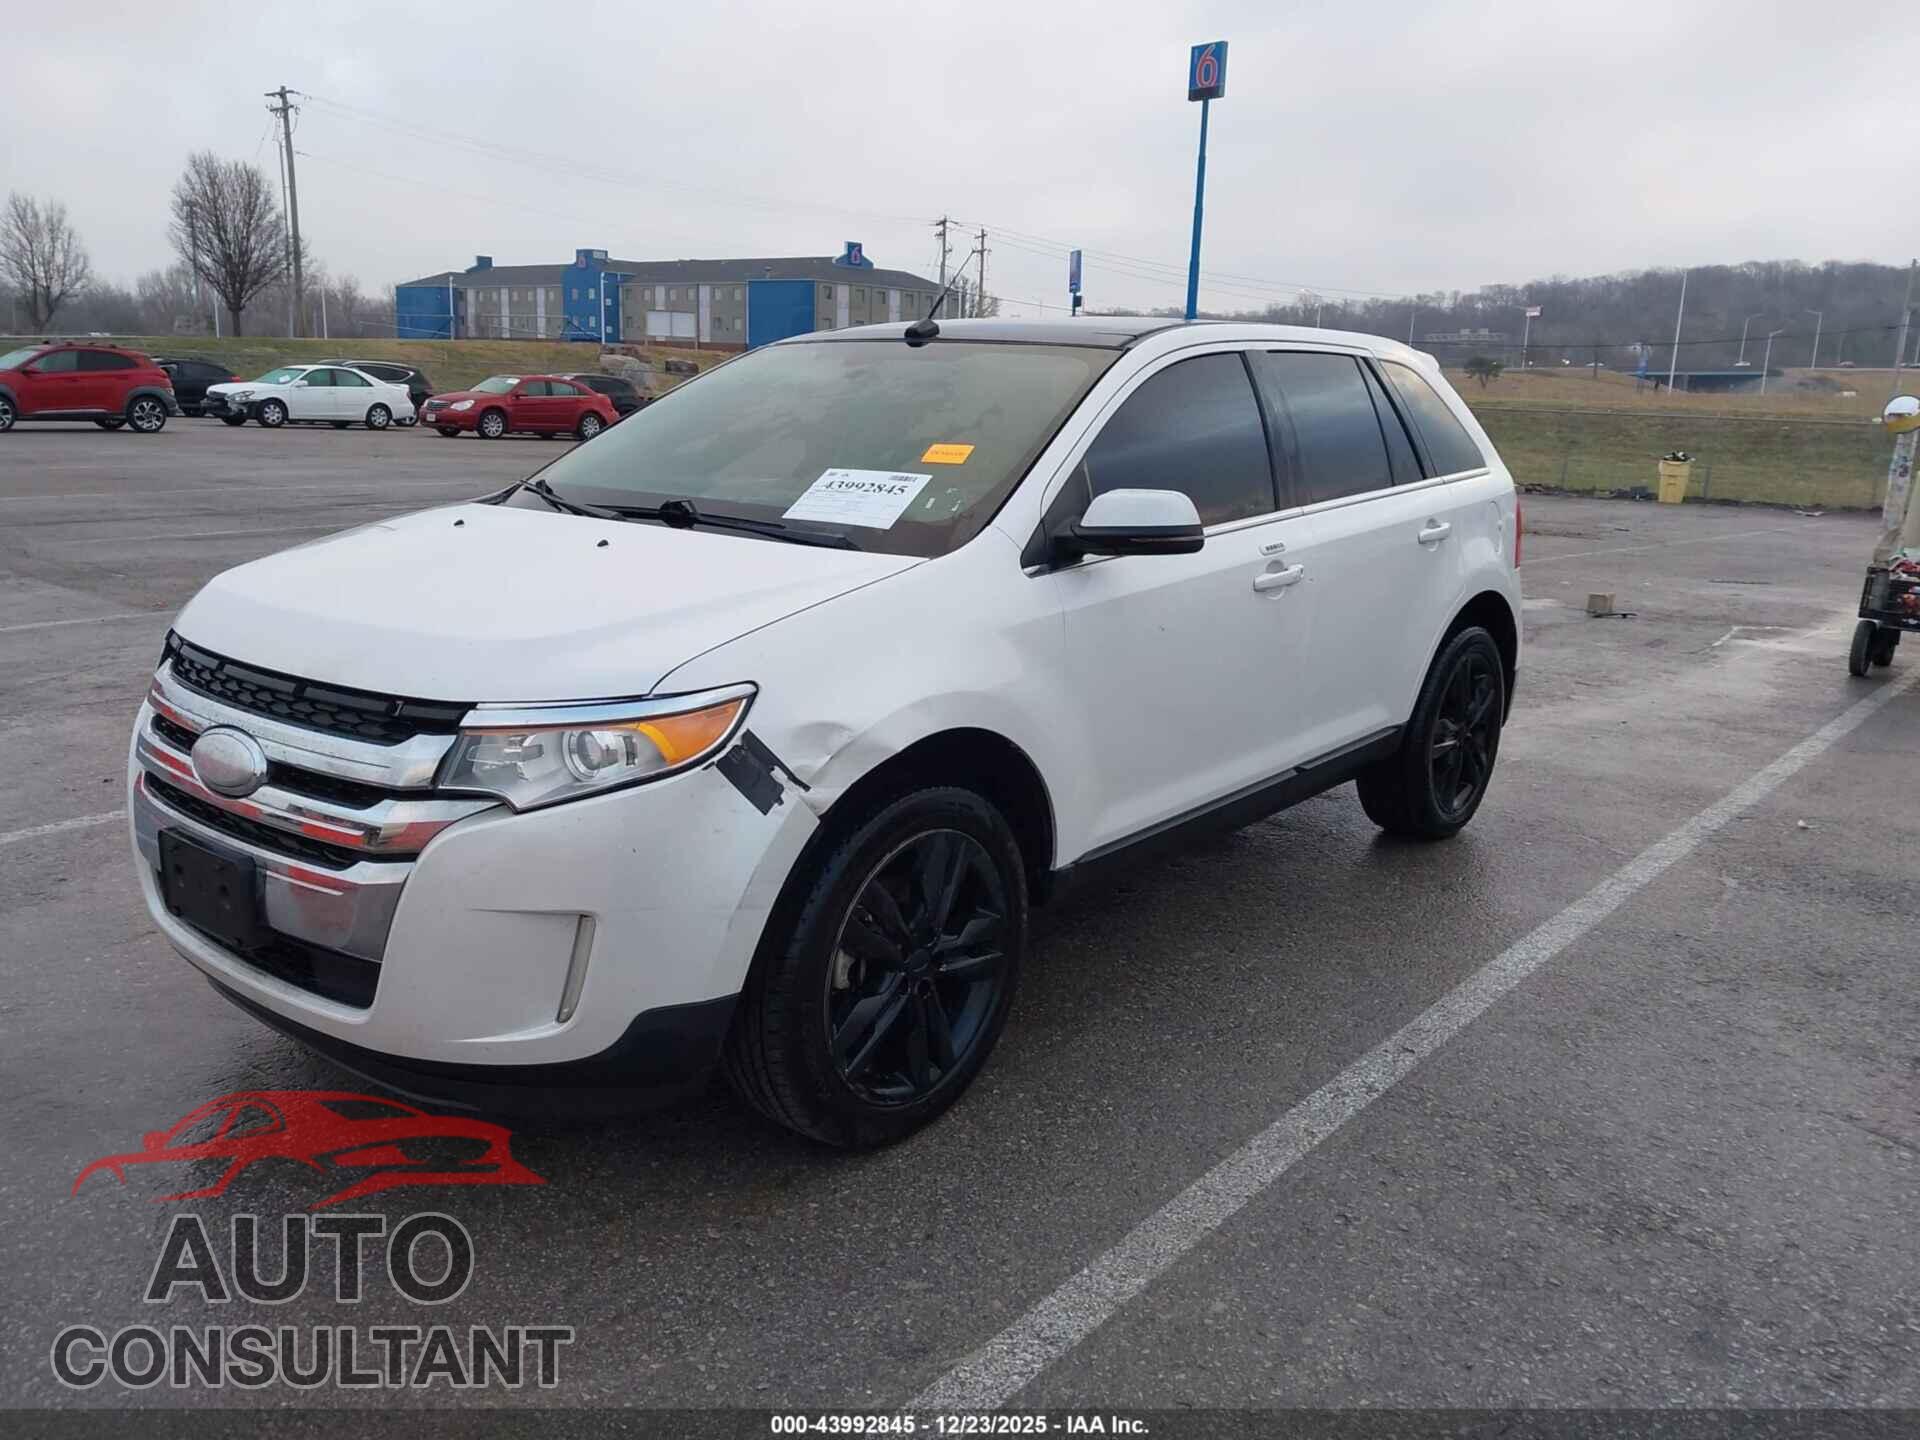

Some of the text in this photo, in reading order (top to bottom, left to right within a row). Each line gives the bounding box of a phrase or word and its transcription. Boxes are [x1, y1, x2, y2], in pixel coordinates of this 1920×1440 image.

[1197, 44, 1217, 88] 6
[851, 246, 861, 264] 6
[825, 480, 908, 495] 43992845
